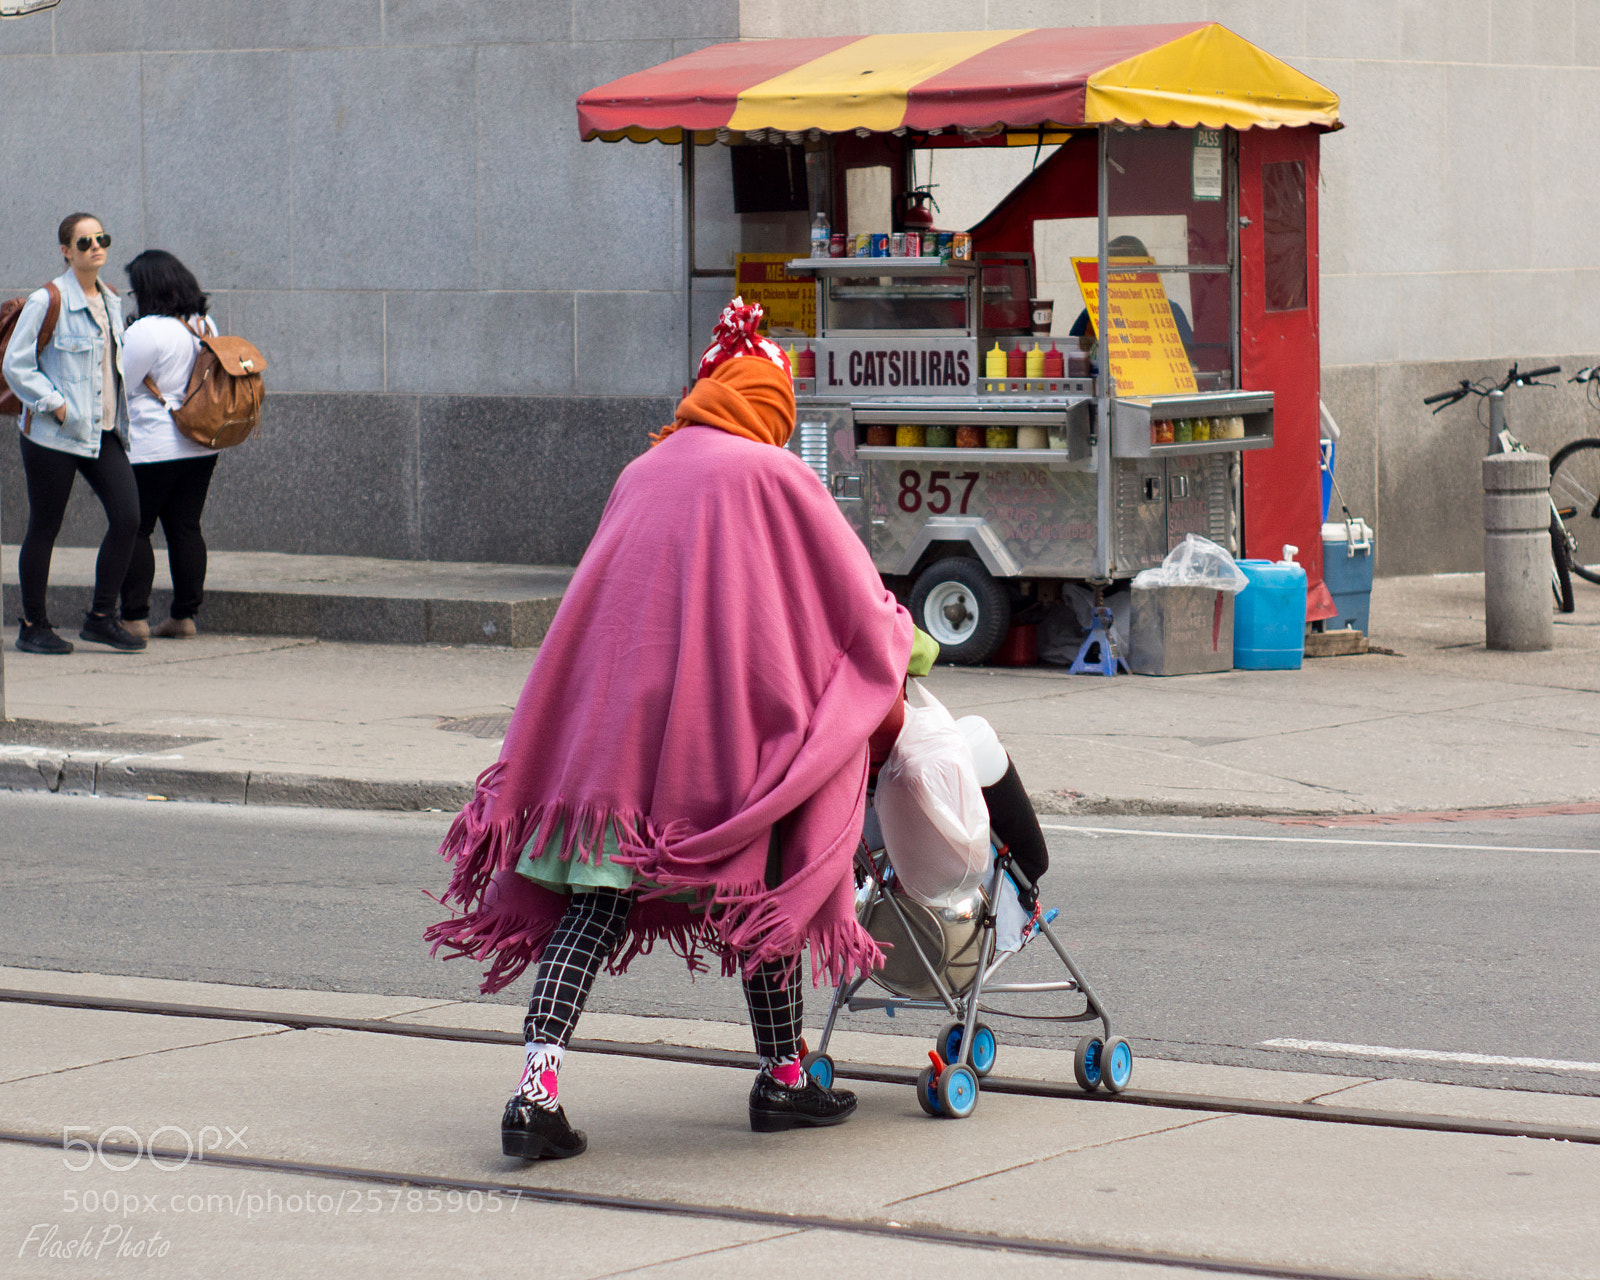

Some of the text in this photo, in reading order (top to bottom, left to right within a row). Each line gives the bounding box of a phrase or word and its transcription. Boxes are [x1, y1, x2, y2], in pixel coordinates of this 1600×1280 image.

[1198, 130, 1219, 146] PASS
[1119, 332, 1130, 344] Hot
[828, 350, 970, 387] L. CATSILIRAS
[898, 469, 980, 514] 857
